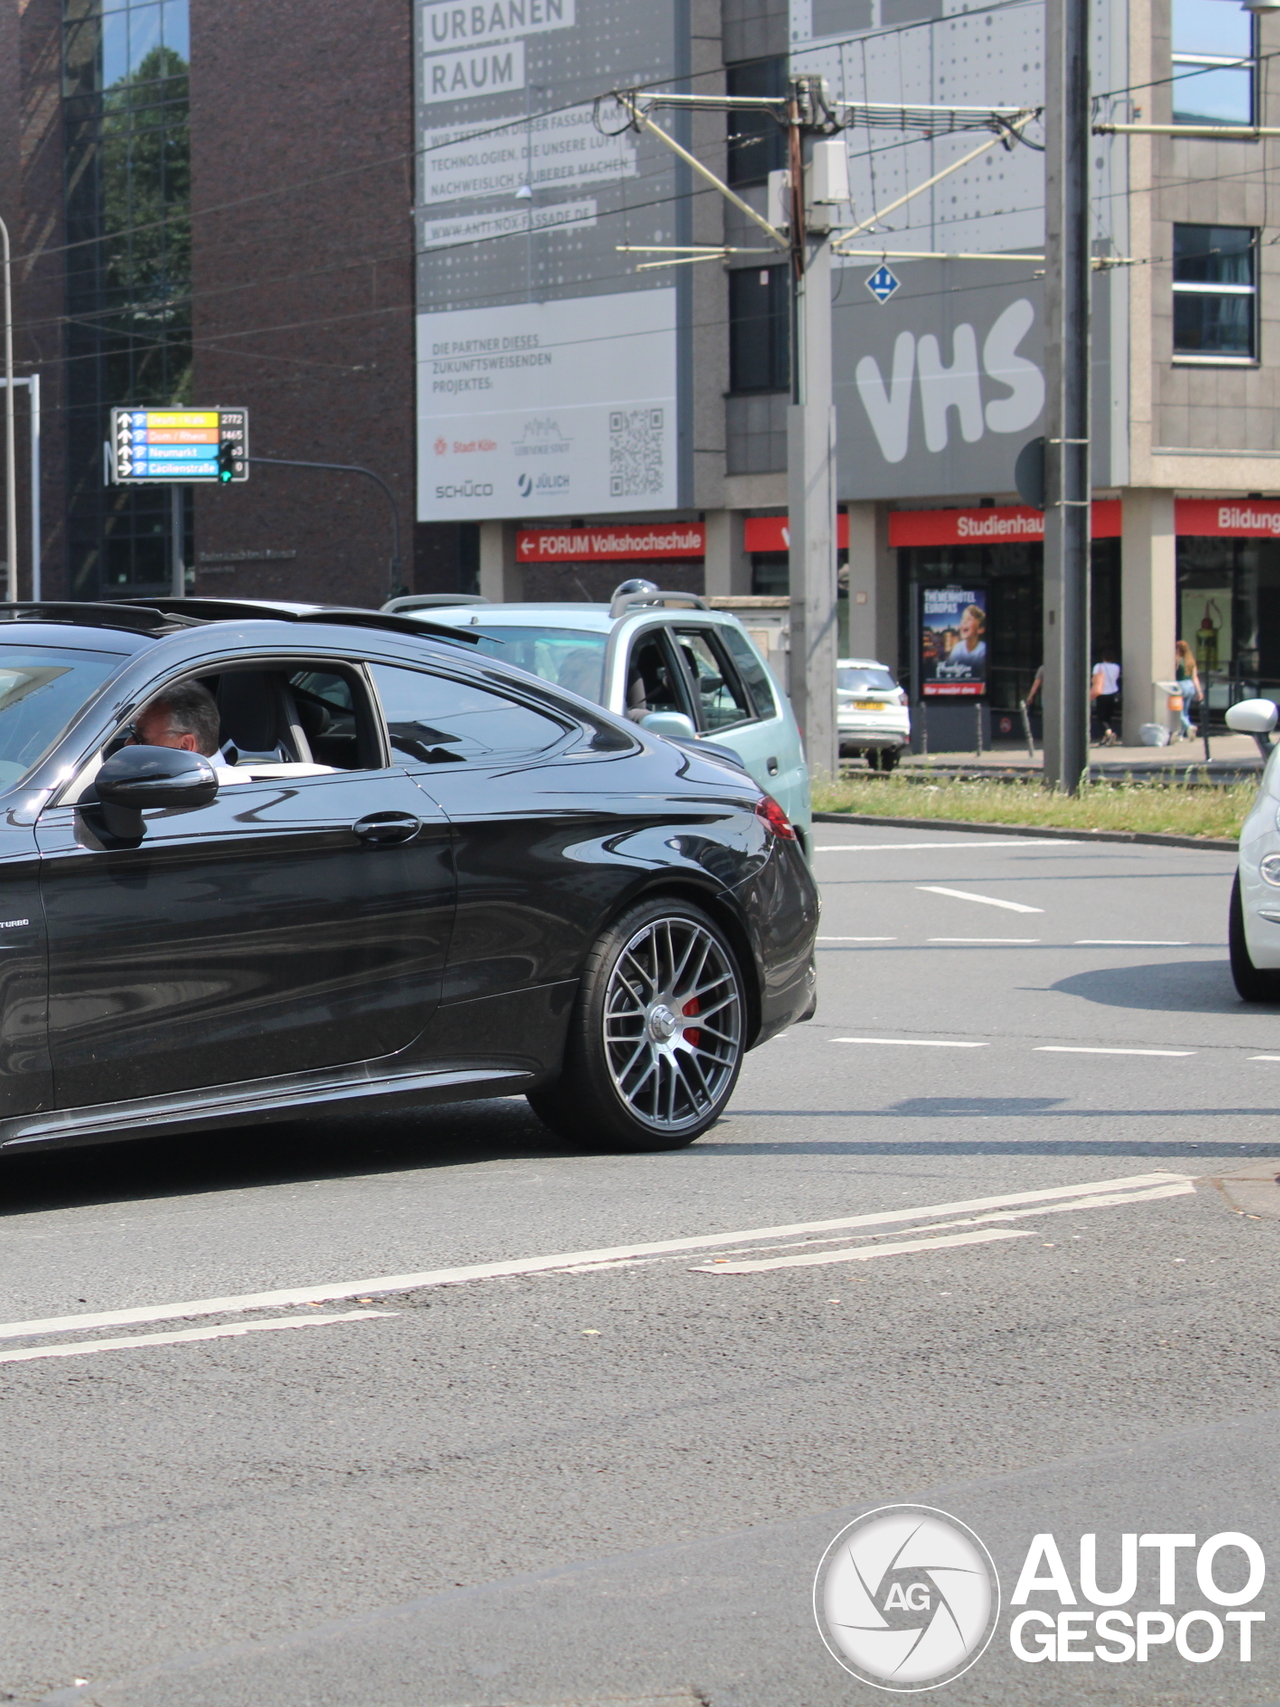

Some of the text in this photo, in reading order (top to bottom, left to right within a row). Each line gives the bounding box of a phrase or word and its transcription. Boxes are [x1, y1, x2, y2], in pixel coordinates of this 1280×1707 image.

[431, 0, 563, 42] URBANEN
[432, 53, 513, 94] RAUM
[430, 132, 451, 146] WIR
[494, 125, 510, 138] AN
[512, 118, 549, 135] DIESER
[521, 144, 540, 159] DIE
[543, 138, 586, 156] UNSERE
[590, 135, 617, 149] LUFT
[431, 157, 632, 196] NACHWEISLICH SAUBERER MACHEN.
[432, 334, 539, 355] DIE PARTNER DIESES
[432, 352, 552, 375] ZUKUNFTSWEISENDEN
[432, 376, 494, 395] PROJEKTES:
[855, 298, 1046, 464] VHS
[221, 414, 243, 424] 2772
[150, 432, 172, 441] Dom
[180, 431, 207, 440] Rhein
[221, 430, 243, 440] 1465
[453, 438, 498, 453] Stadt Köln
[150, 448, 197, 457] Neumarkt
[150, 463, 216, 474] Cäcilienstraße
[435, 480, 493, 498] SCHÜCO
[535, 473, 570, 488] JÜLICH
[539, 531, 702, 554] FORUM Volkshochschule
